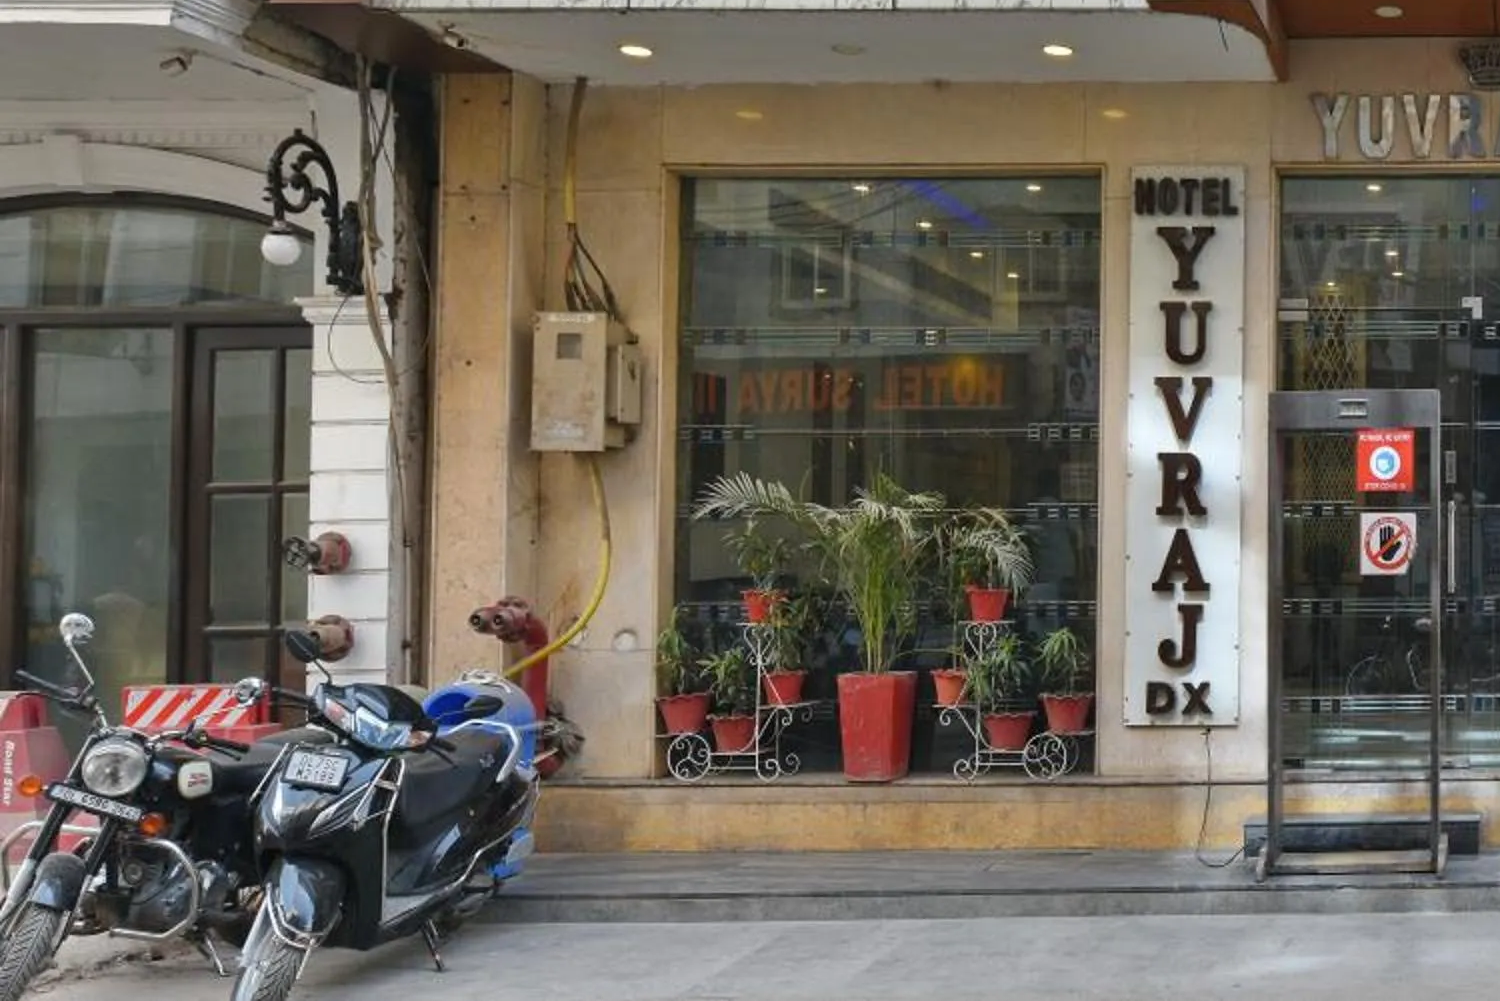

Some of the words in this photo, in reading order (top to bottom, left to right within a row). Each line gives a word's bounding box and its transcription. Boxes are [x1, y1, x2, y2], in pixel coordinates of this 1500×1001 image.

[1134, 177, 1239, 216] HOTEL
[1151, 226, 1216, 669] YUVRAJ
[1144, 681, 1212, 716] DX
